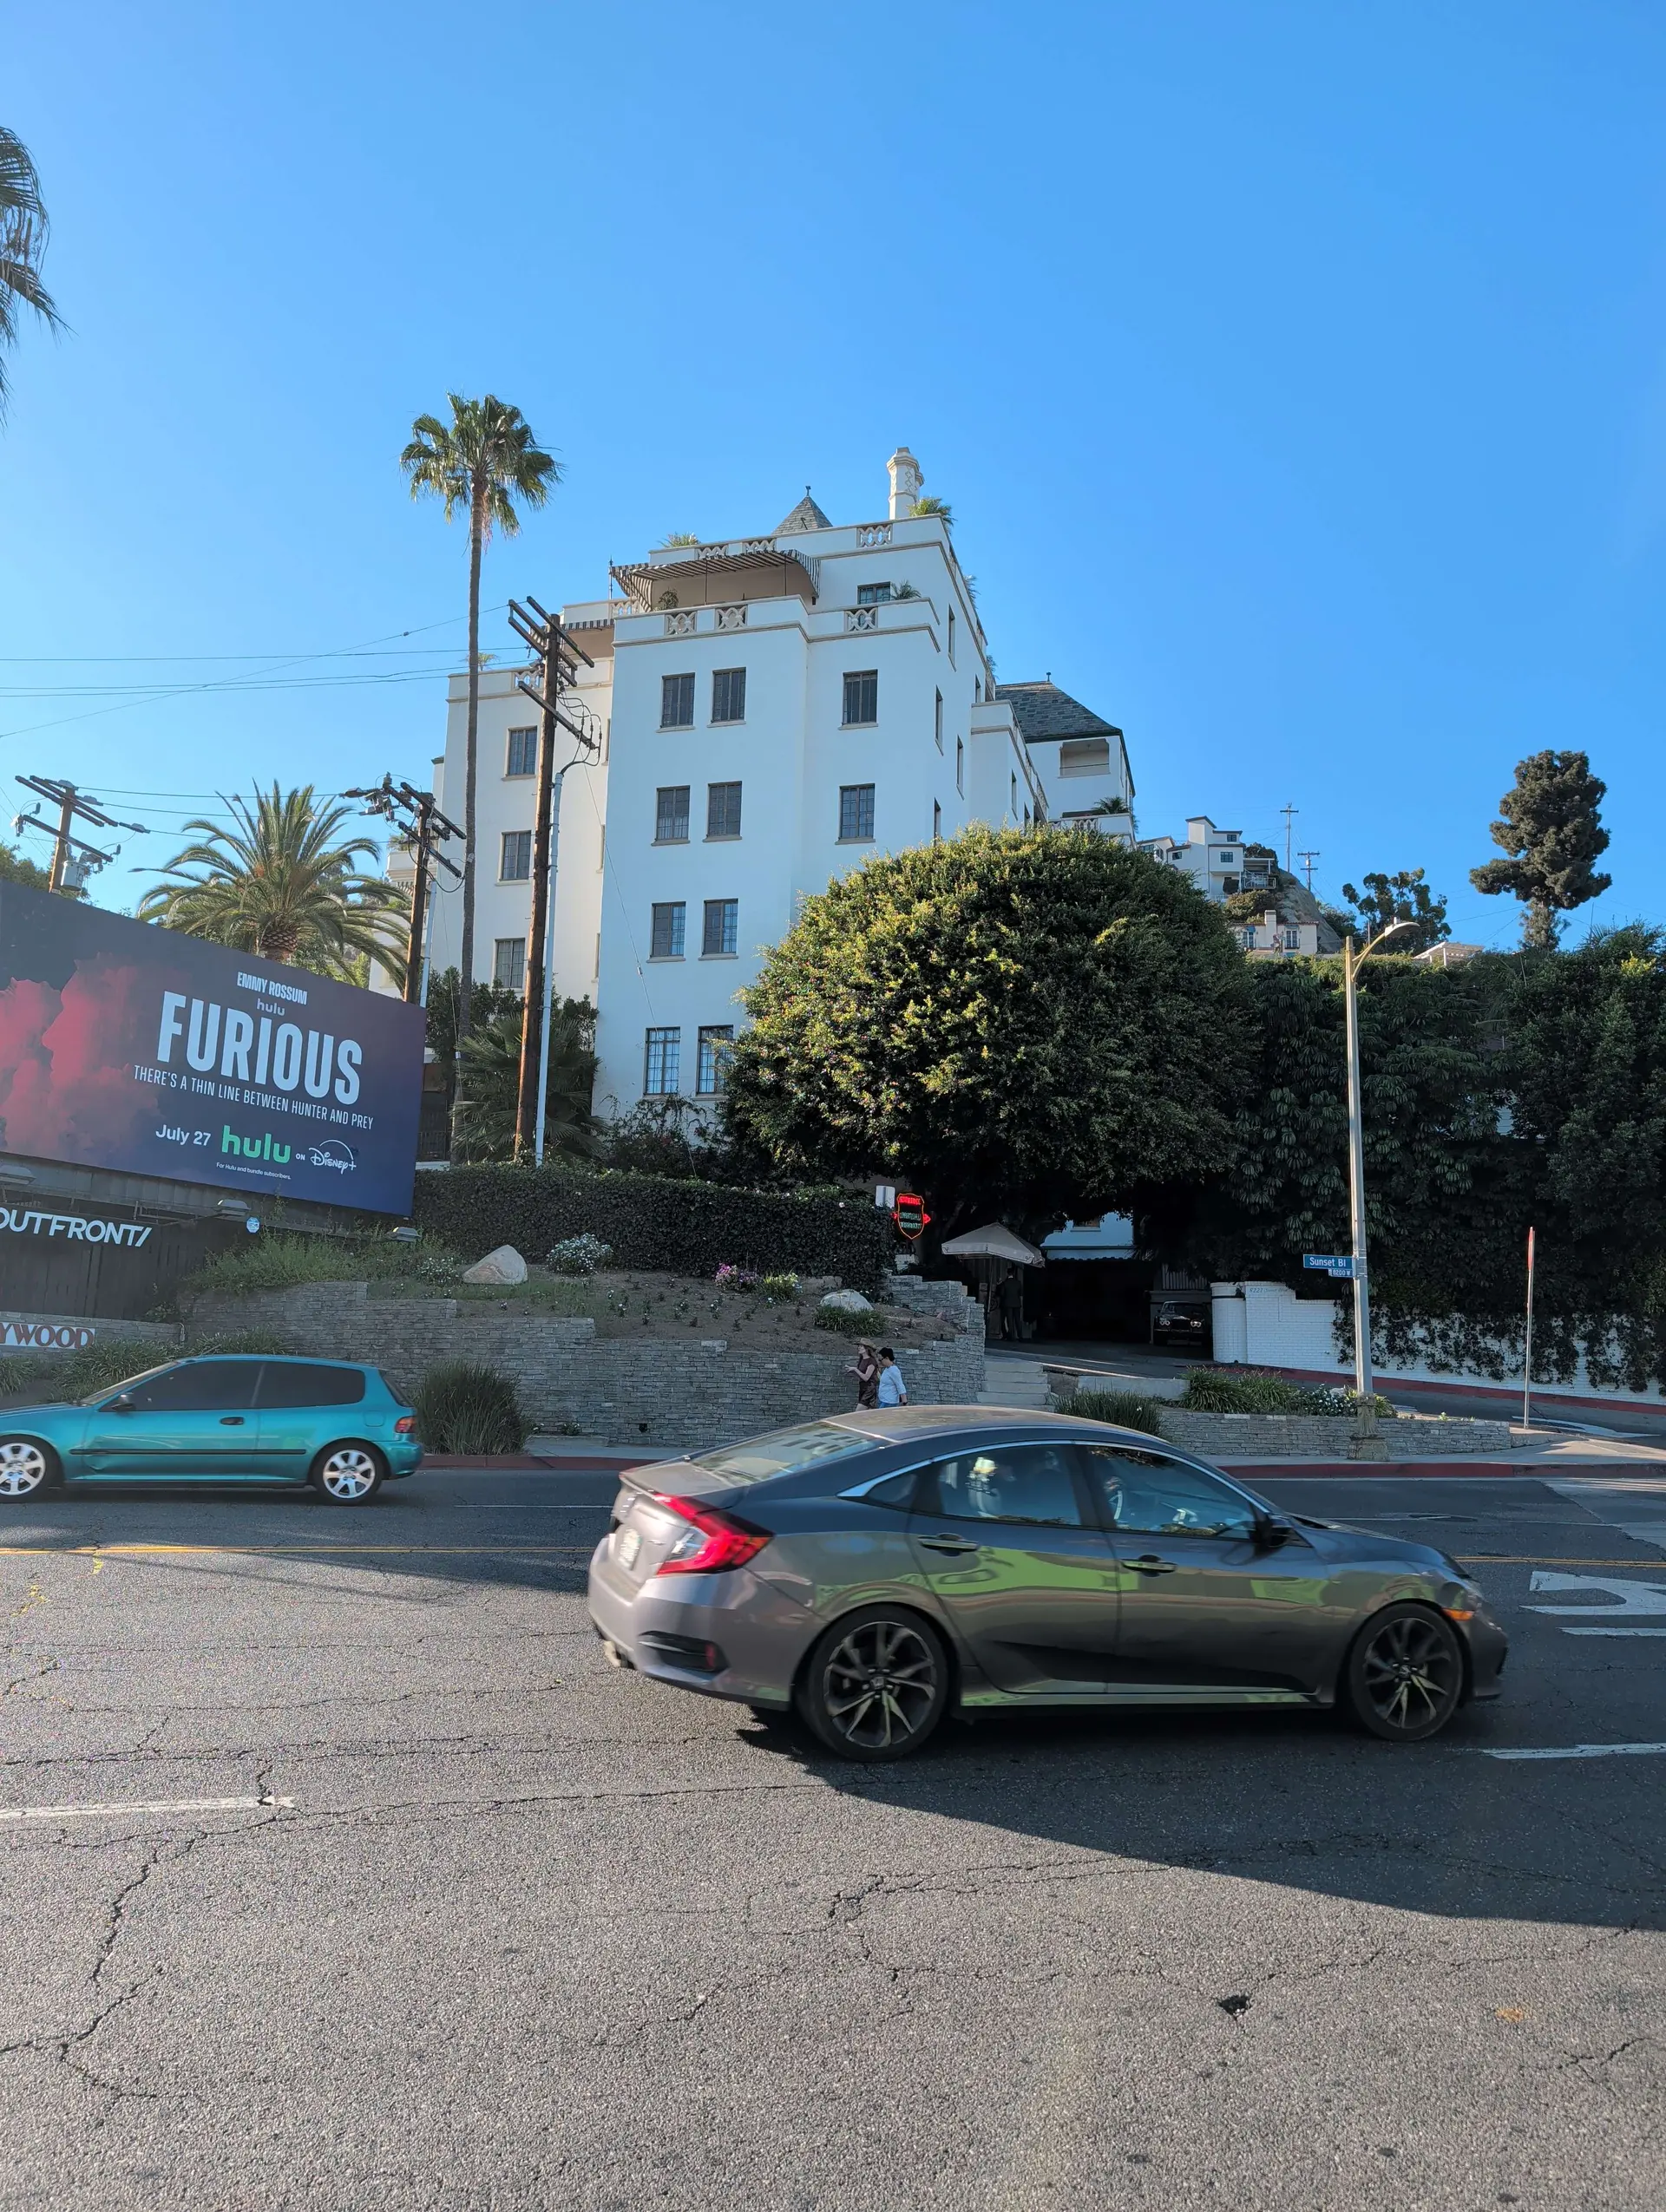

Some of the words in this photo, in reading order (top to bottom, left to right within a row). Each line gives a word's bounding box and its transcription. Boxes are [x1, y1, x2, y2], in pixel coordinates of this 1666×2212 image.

[237, 972, 268, 993] EMMY
[268, 981, 308, 1005] ROSSUM
[256, 998, 285, 1016] hulu
[157, 991, 363, 1105] FURIOUS
[134, 1064, 177, 1088] THERE'S
[180, 1076, 187, 1090] A
[191, 1077, 215, 1096] THIN
[218, 1083, 240, 1102] LINE
[243, 1090, 289, 1112] BETWEEN
[291, 1100, 327, 1121] HUNTER
[329, 1109, 349, 1125] AND
[351, 1113, 374, 1130] PREY
[155, 1124, 190, 1145] July
[193, 1131, 212, 1147] 27
[221, 1125, 292, 1163] hulu
[246, 1167, 264, 1175] bundle
[1309, 1256, 1335, 1266] Sunset
